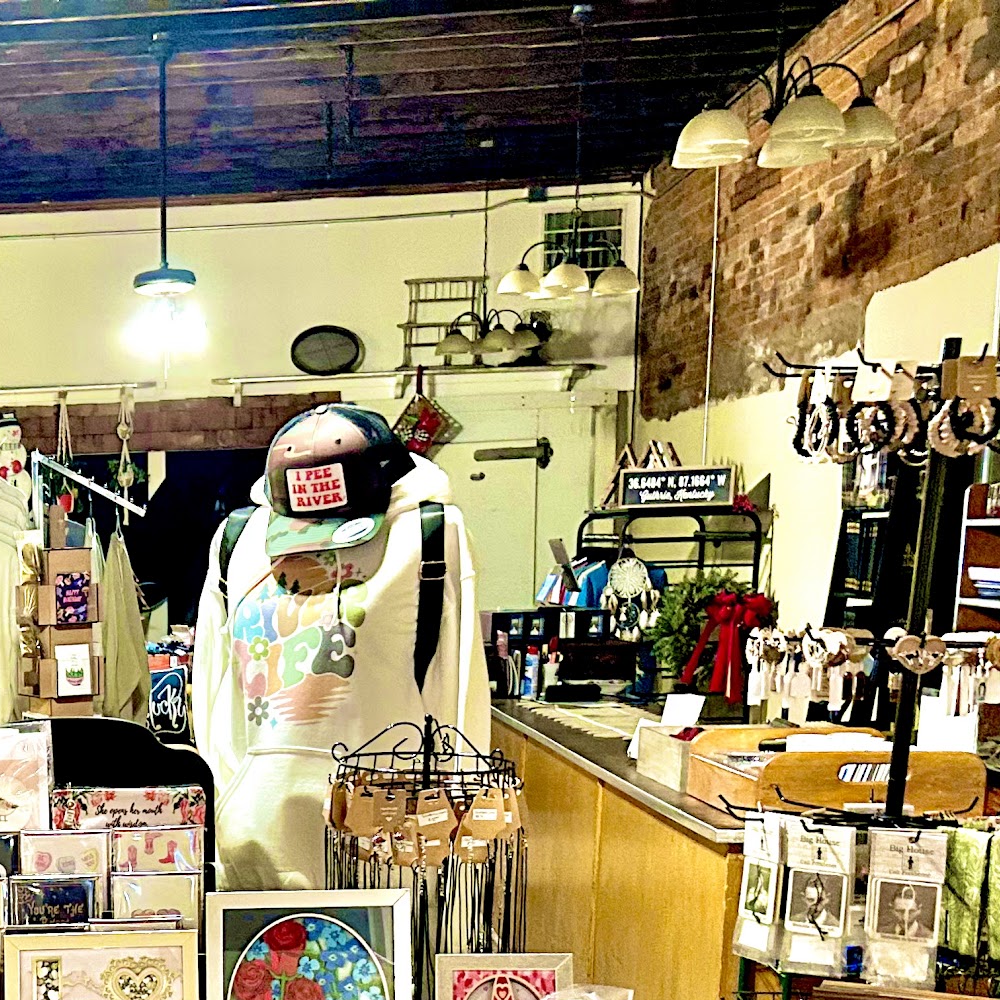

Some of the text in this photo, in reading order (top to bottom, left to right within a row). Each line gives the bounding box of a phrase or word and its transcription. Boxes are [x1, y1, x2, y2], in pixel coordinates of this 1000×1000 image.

[296, 467, 332, 481] I PEE
[717, 474, 727, 486] W
[292, 479, 340, 494] IN THE
[296, 492, 343, 507] RIVER
[674, 488, 715, 502] Kentucky
[129, 802, 141, 815] her
[906, 846, 935, 856] House
[63, 902, 84, 915] THE
